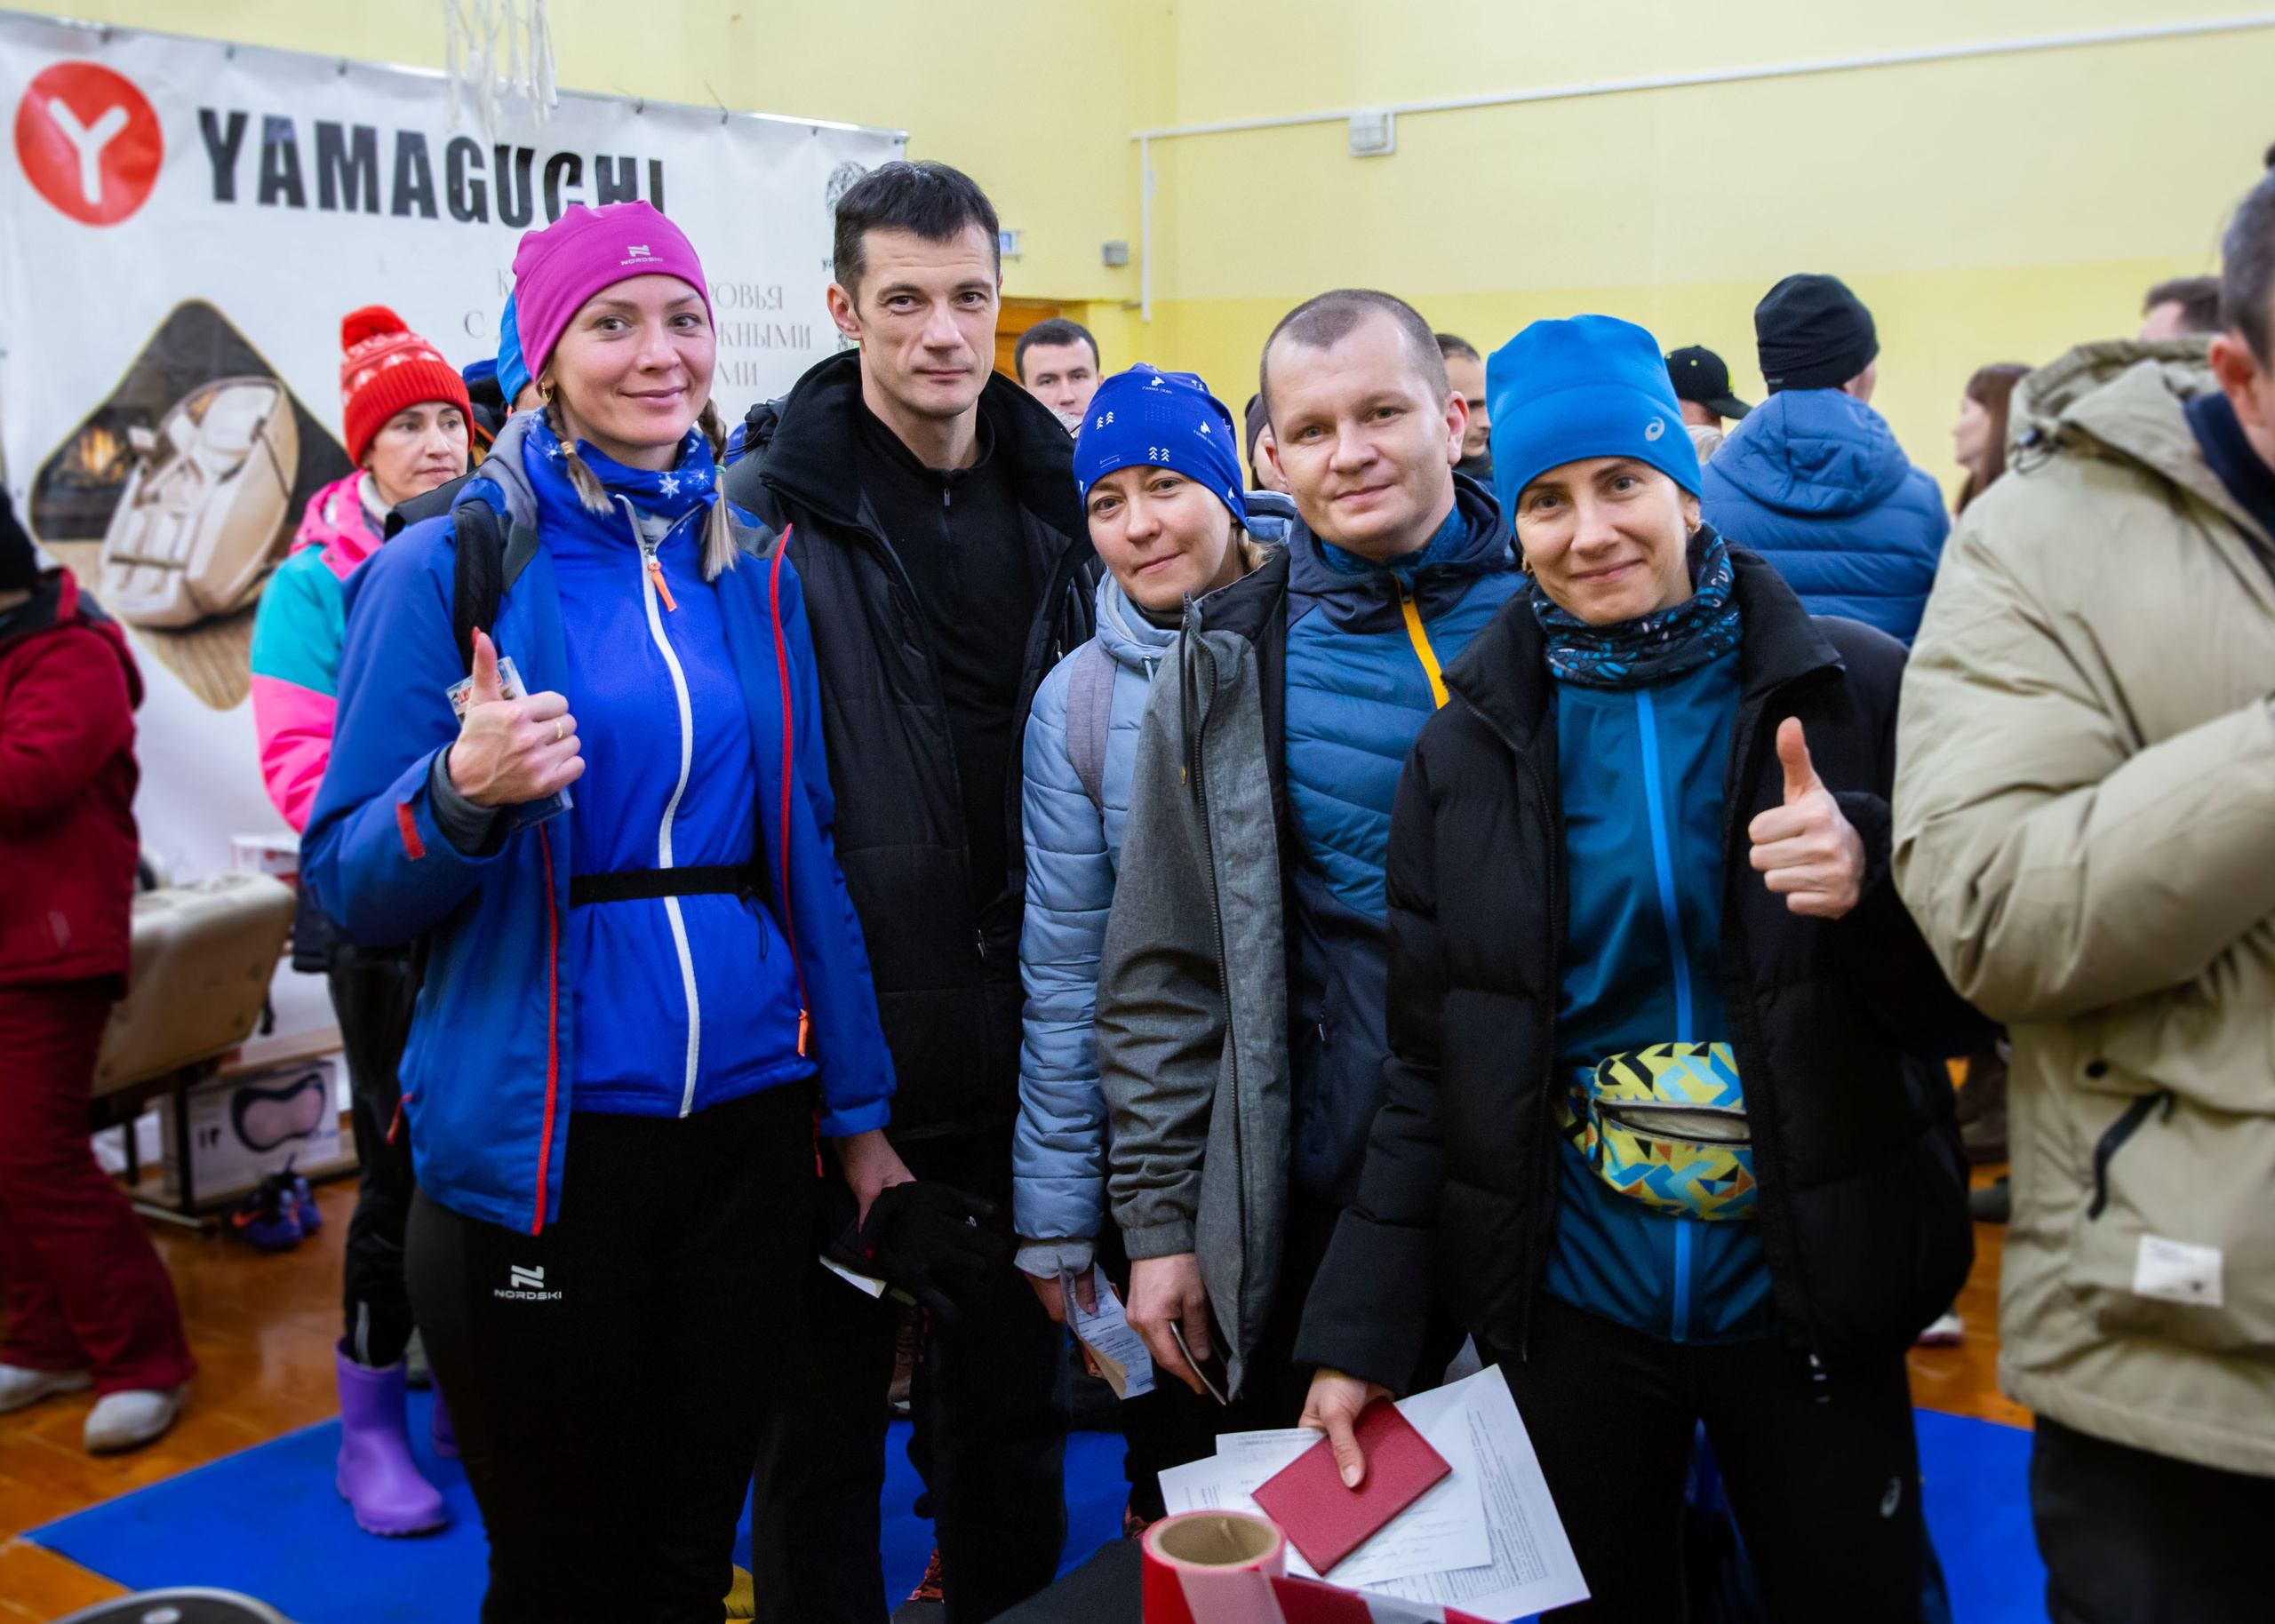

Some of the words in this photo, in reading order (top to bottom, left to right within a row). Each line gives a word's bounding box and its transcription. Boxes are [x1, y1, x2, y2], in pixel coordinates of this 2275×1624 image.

[197, 107, 665, 228] YAMAGUCHI
[620, 257, 664, 266] NORDSKI
[710, 282, 783, 311] ОВЬЯ
[494, 1289, 562, 1300] NORDSKI
